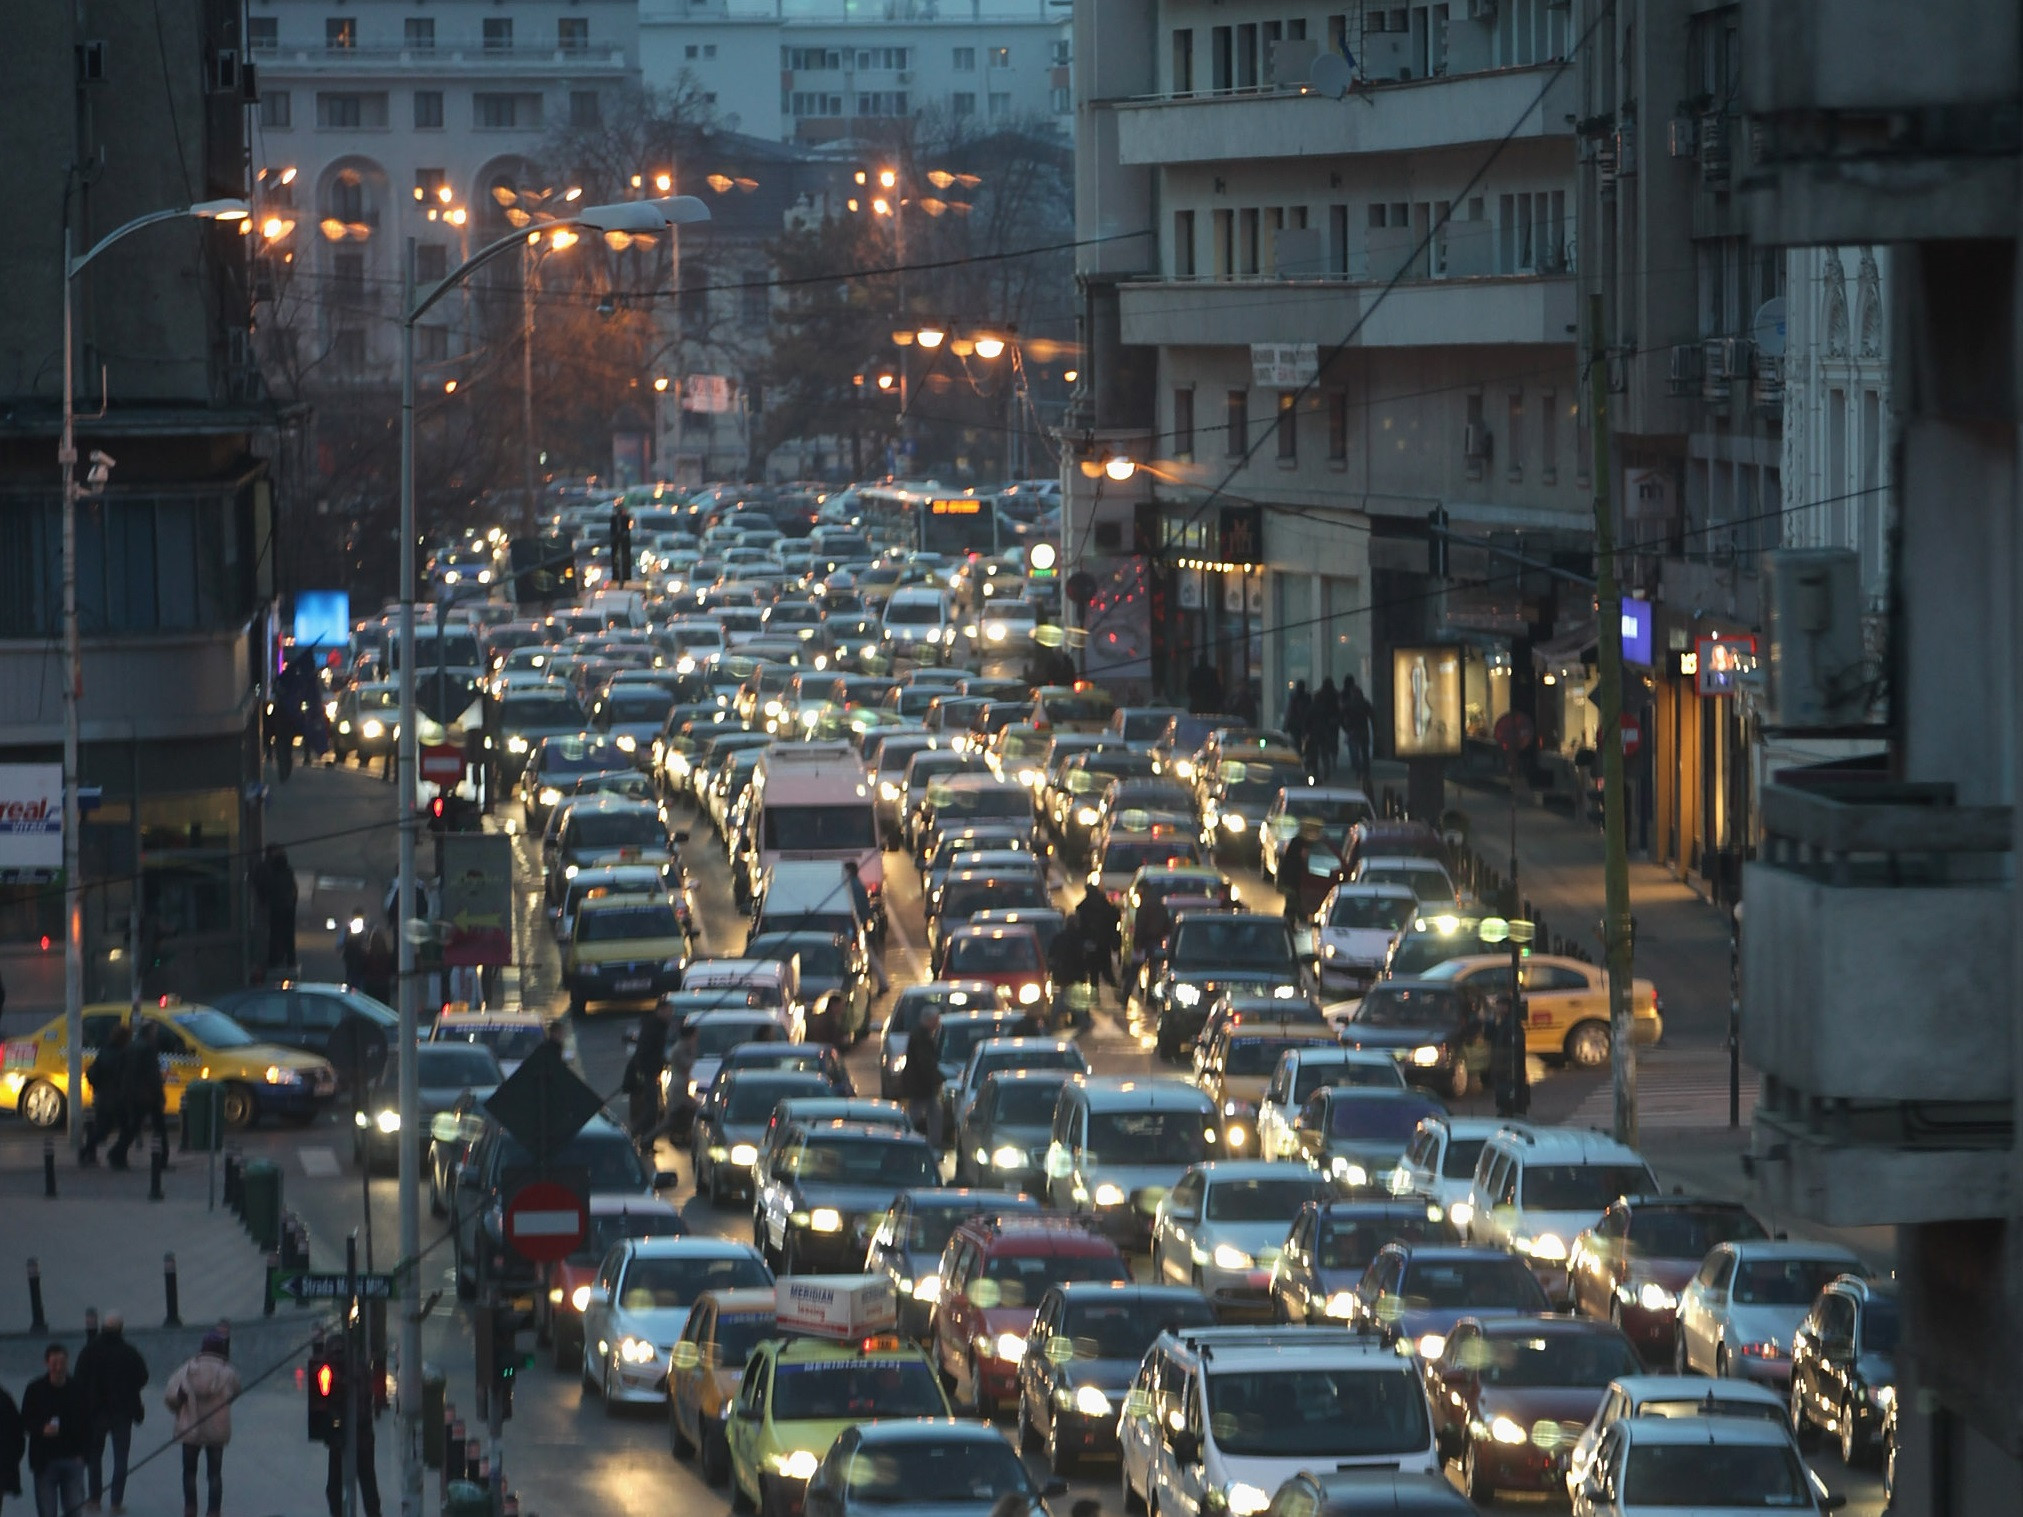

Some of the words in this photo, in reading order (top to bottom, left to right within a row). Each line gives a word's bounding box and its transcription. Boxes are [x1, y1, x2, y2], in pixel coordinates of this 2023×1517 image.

[302, 1277, 334, 1296] Strada
[790, 1285, 834, 1303] MERIDIAN
[804, 1360, 868, 1372] MERIDIAN
[871, 1360, 900, 1372] TAXI
